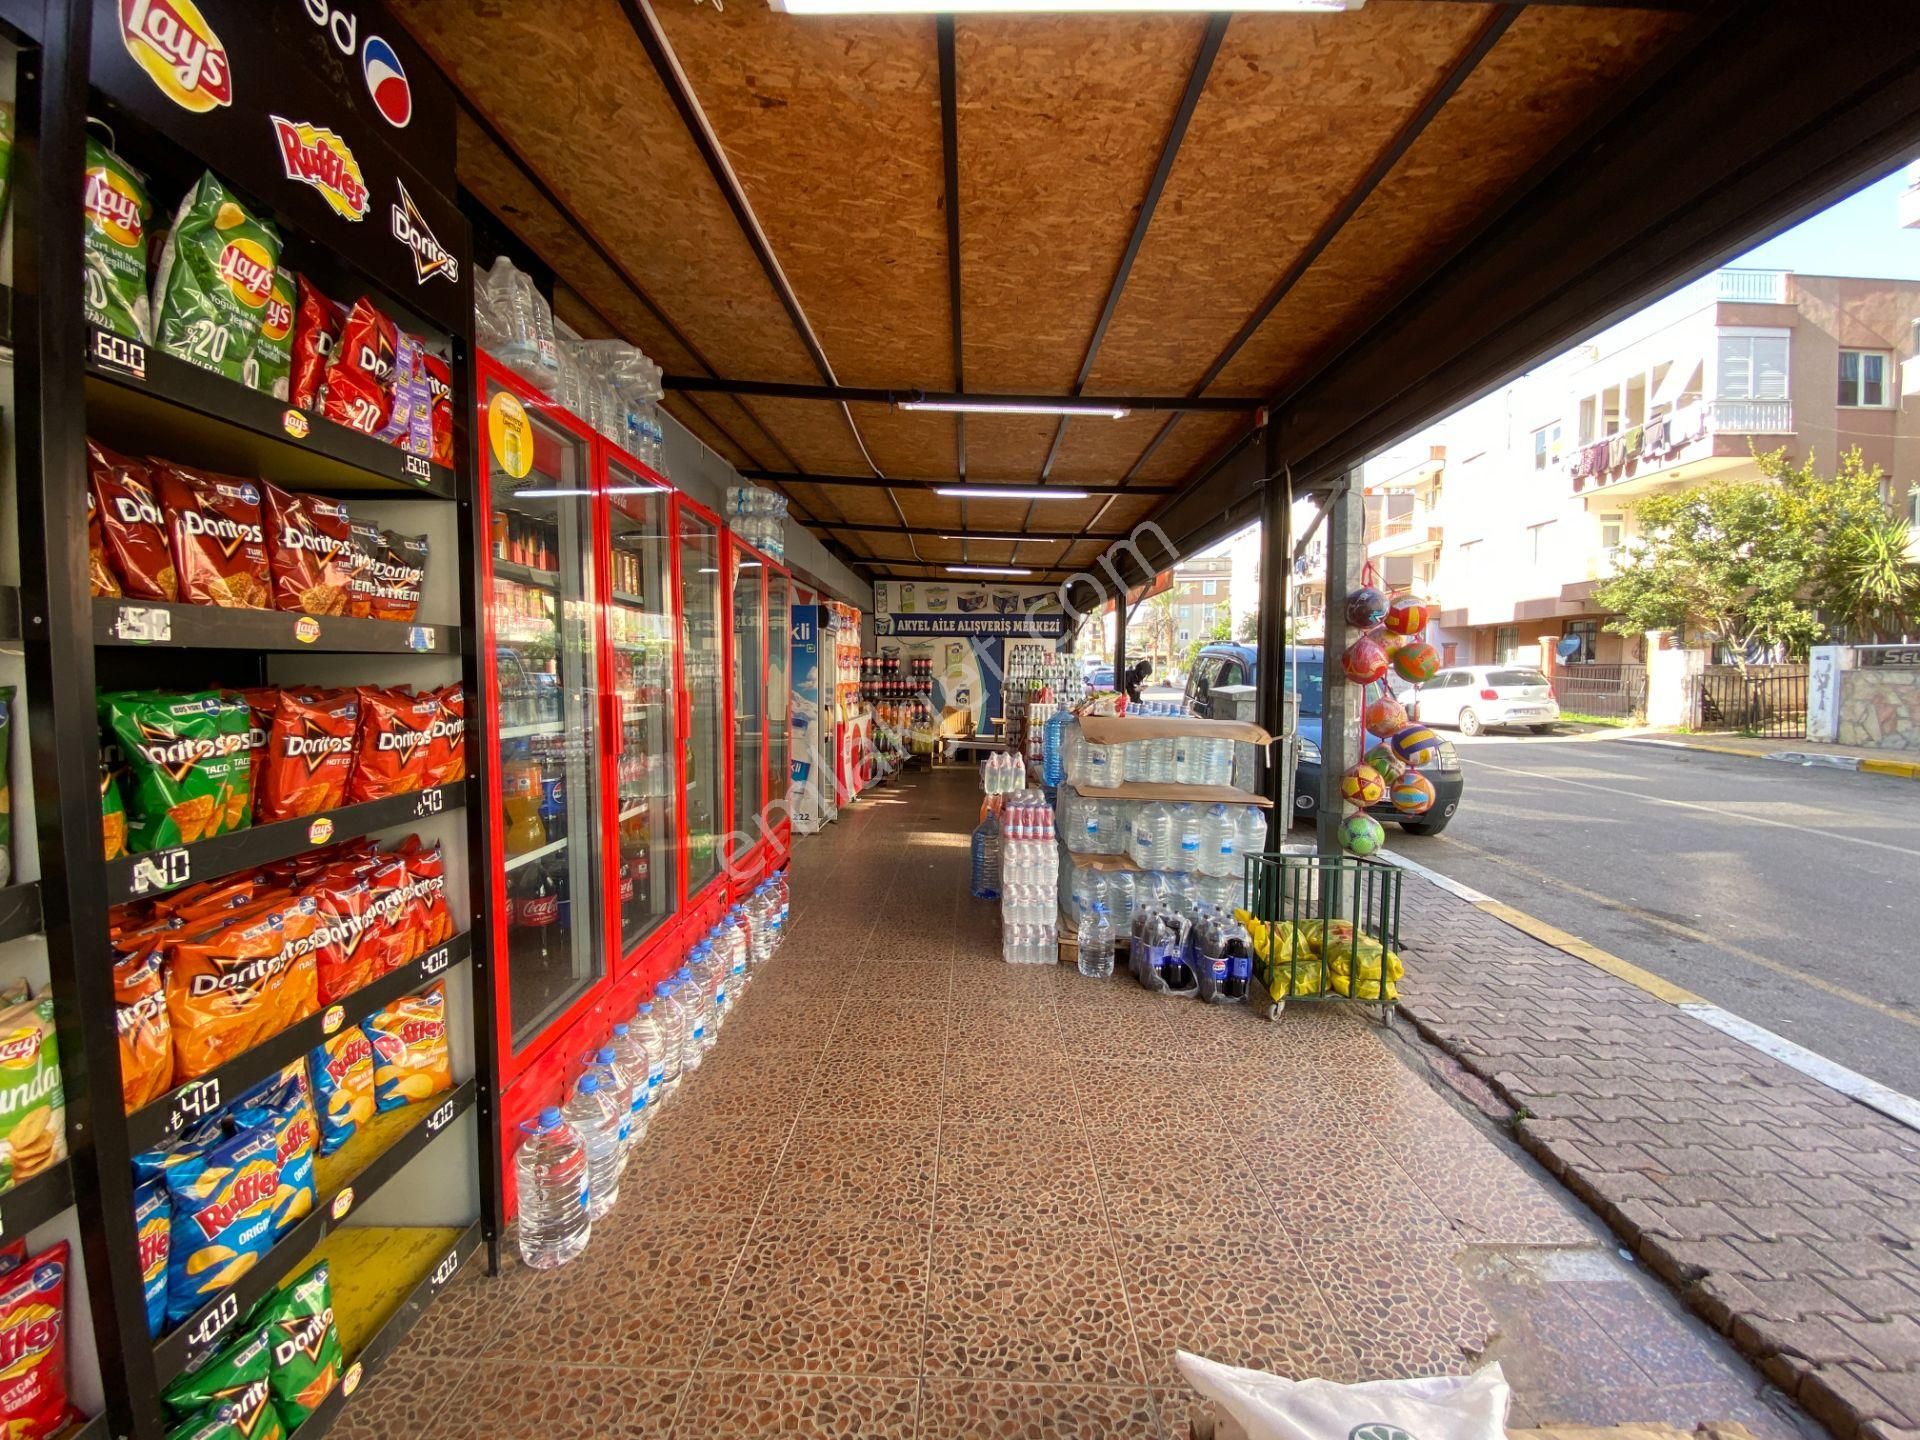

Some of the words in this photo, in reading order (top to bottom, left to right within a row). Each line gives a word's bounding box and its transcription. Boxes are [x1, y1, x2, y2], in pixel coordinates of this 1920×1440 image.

[277, 124, 369, 214] Ruffles
[392, 205, 458, 282] Doritos
[184, 511, 263, 543] Doritos
[284, 527, 352, 556] Doritos
[374, 562, 424, 582] Doritos
[897, 620, 930, 632] AKYEL
[932, 618, 957, 632] AİLE
[958, 618, 1012, 635] ALIŞVERİŞ
[1013, 618, 1061, 633] MERKEZİ
[287, 736, 352, 757] Doritos
[378, 730, 432, 751] Doritos
[315, 908, 374, 949] Doritos
[374, 1020, 445, 1062] Ruffles
[192, 1169, 280, 1242] Ruffles
[275, 1307, 334, 1366] Dorito
